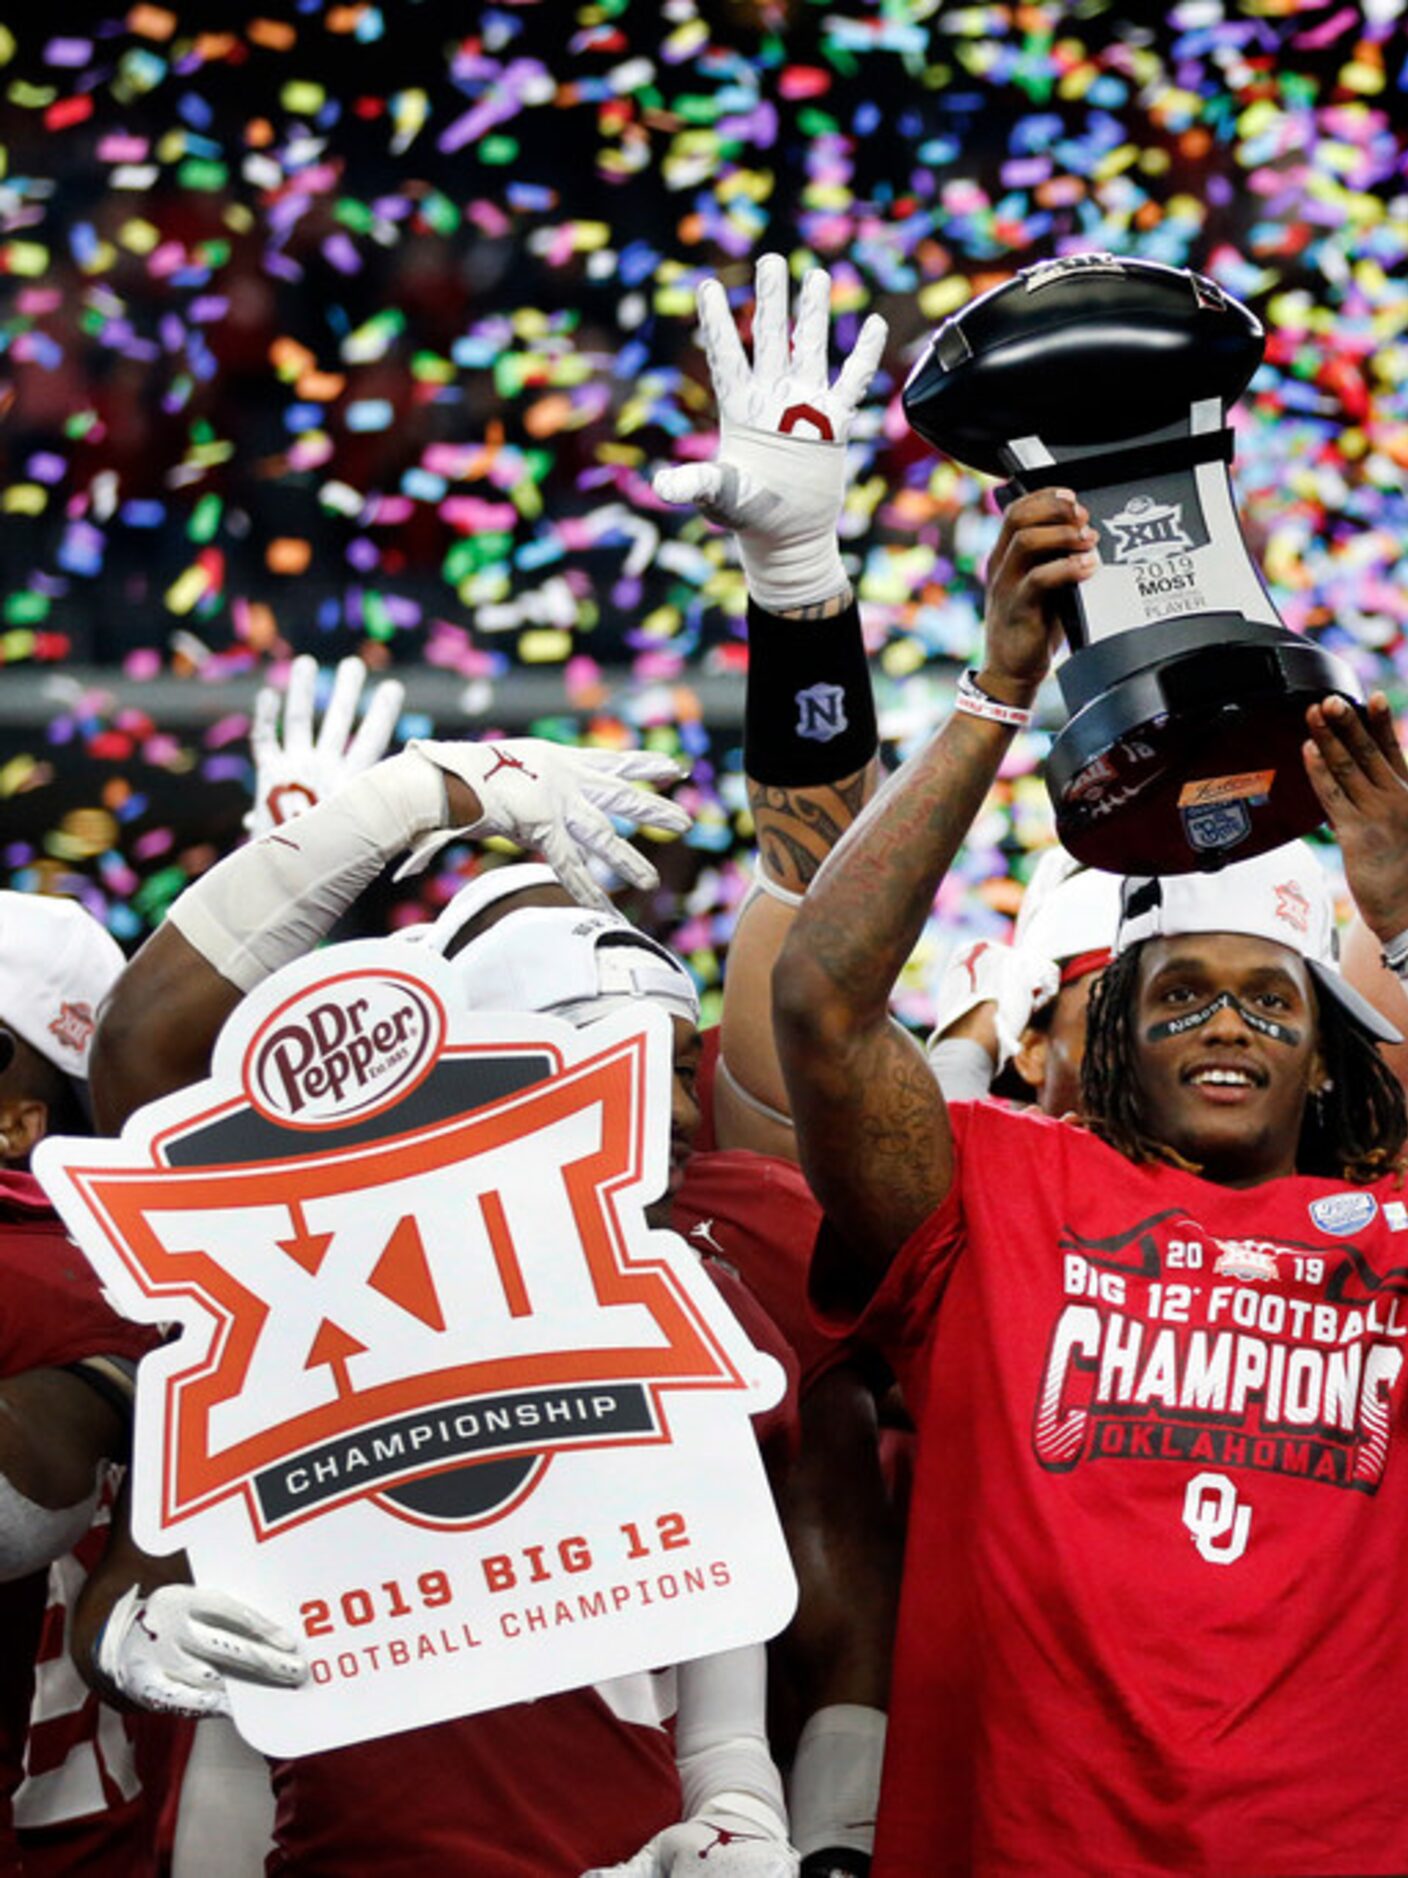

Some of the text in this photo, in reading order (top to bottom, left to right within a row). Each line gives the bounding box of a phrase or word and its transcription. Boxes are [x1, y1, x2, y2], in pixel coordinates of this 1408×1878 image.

[1134, 557, 1194, 583] 2019
[1138, 572, 1195, 597] MOST
[1144, 596, 1207, 617] PLAYER
[257, 1006, 414, 1114] Pepper
[306, 998, 369, 1058] Dr
[139, 1100, 673, 1459] XII
[1064, 1254, 1126, 1304] BIG
[1207, 1287, 1407, 1344] FOOTBALL
[1166, 1241, 1203, 1268] 20
[1292, 1258, 1324, 1284] 19
[1036, 1305, 1404, 1486] CHAMPIONS
[285, 1396, 617, 1494] CHAMPIONSHIP
[1101, 1423, 1354, 1483] OKLAHOMA
[1182, 1472, 1252, 1564] OU
[300, 1512, 691, 1638] 2019 BIG 12
[311, 1560, 732, 1685] OOTBALL CHAMPIONS
